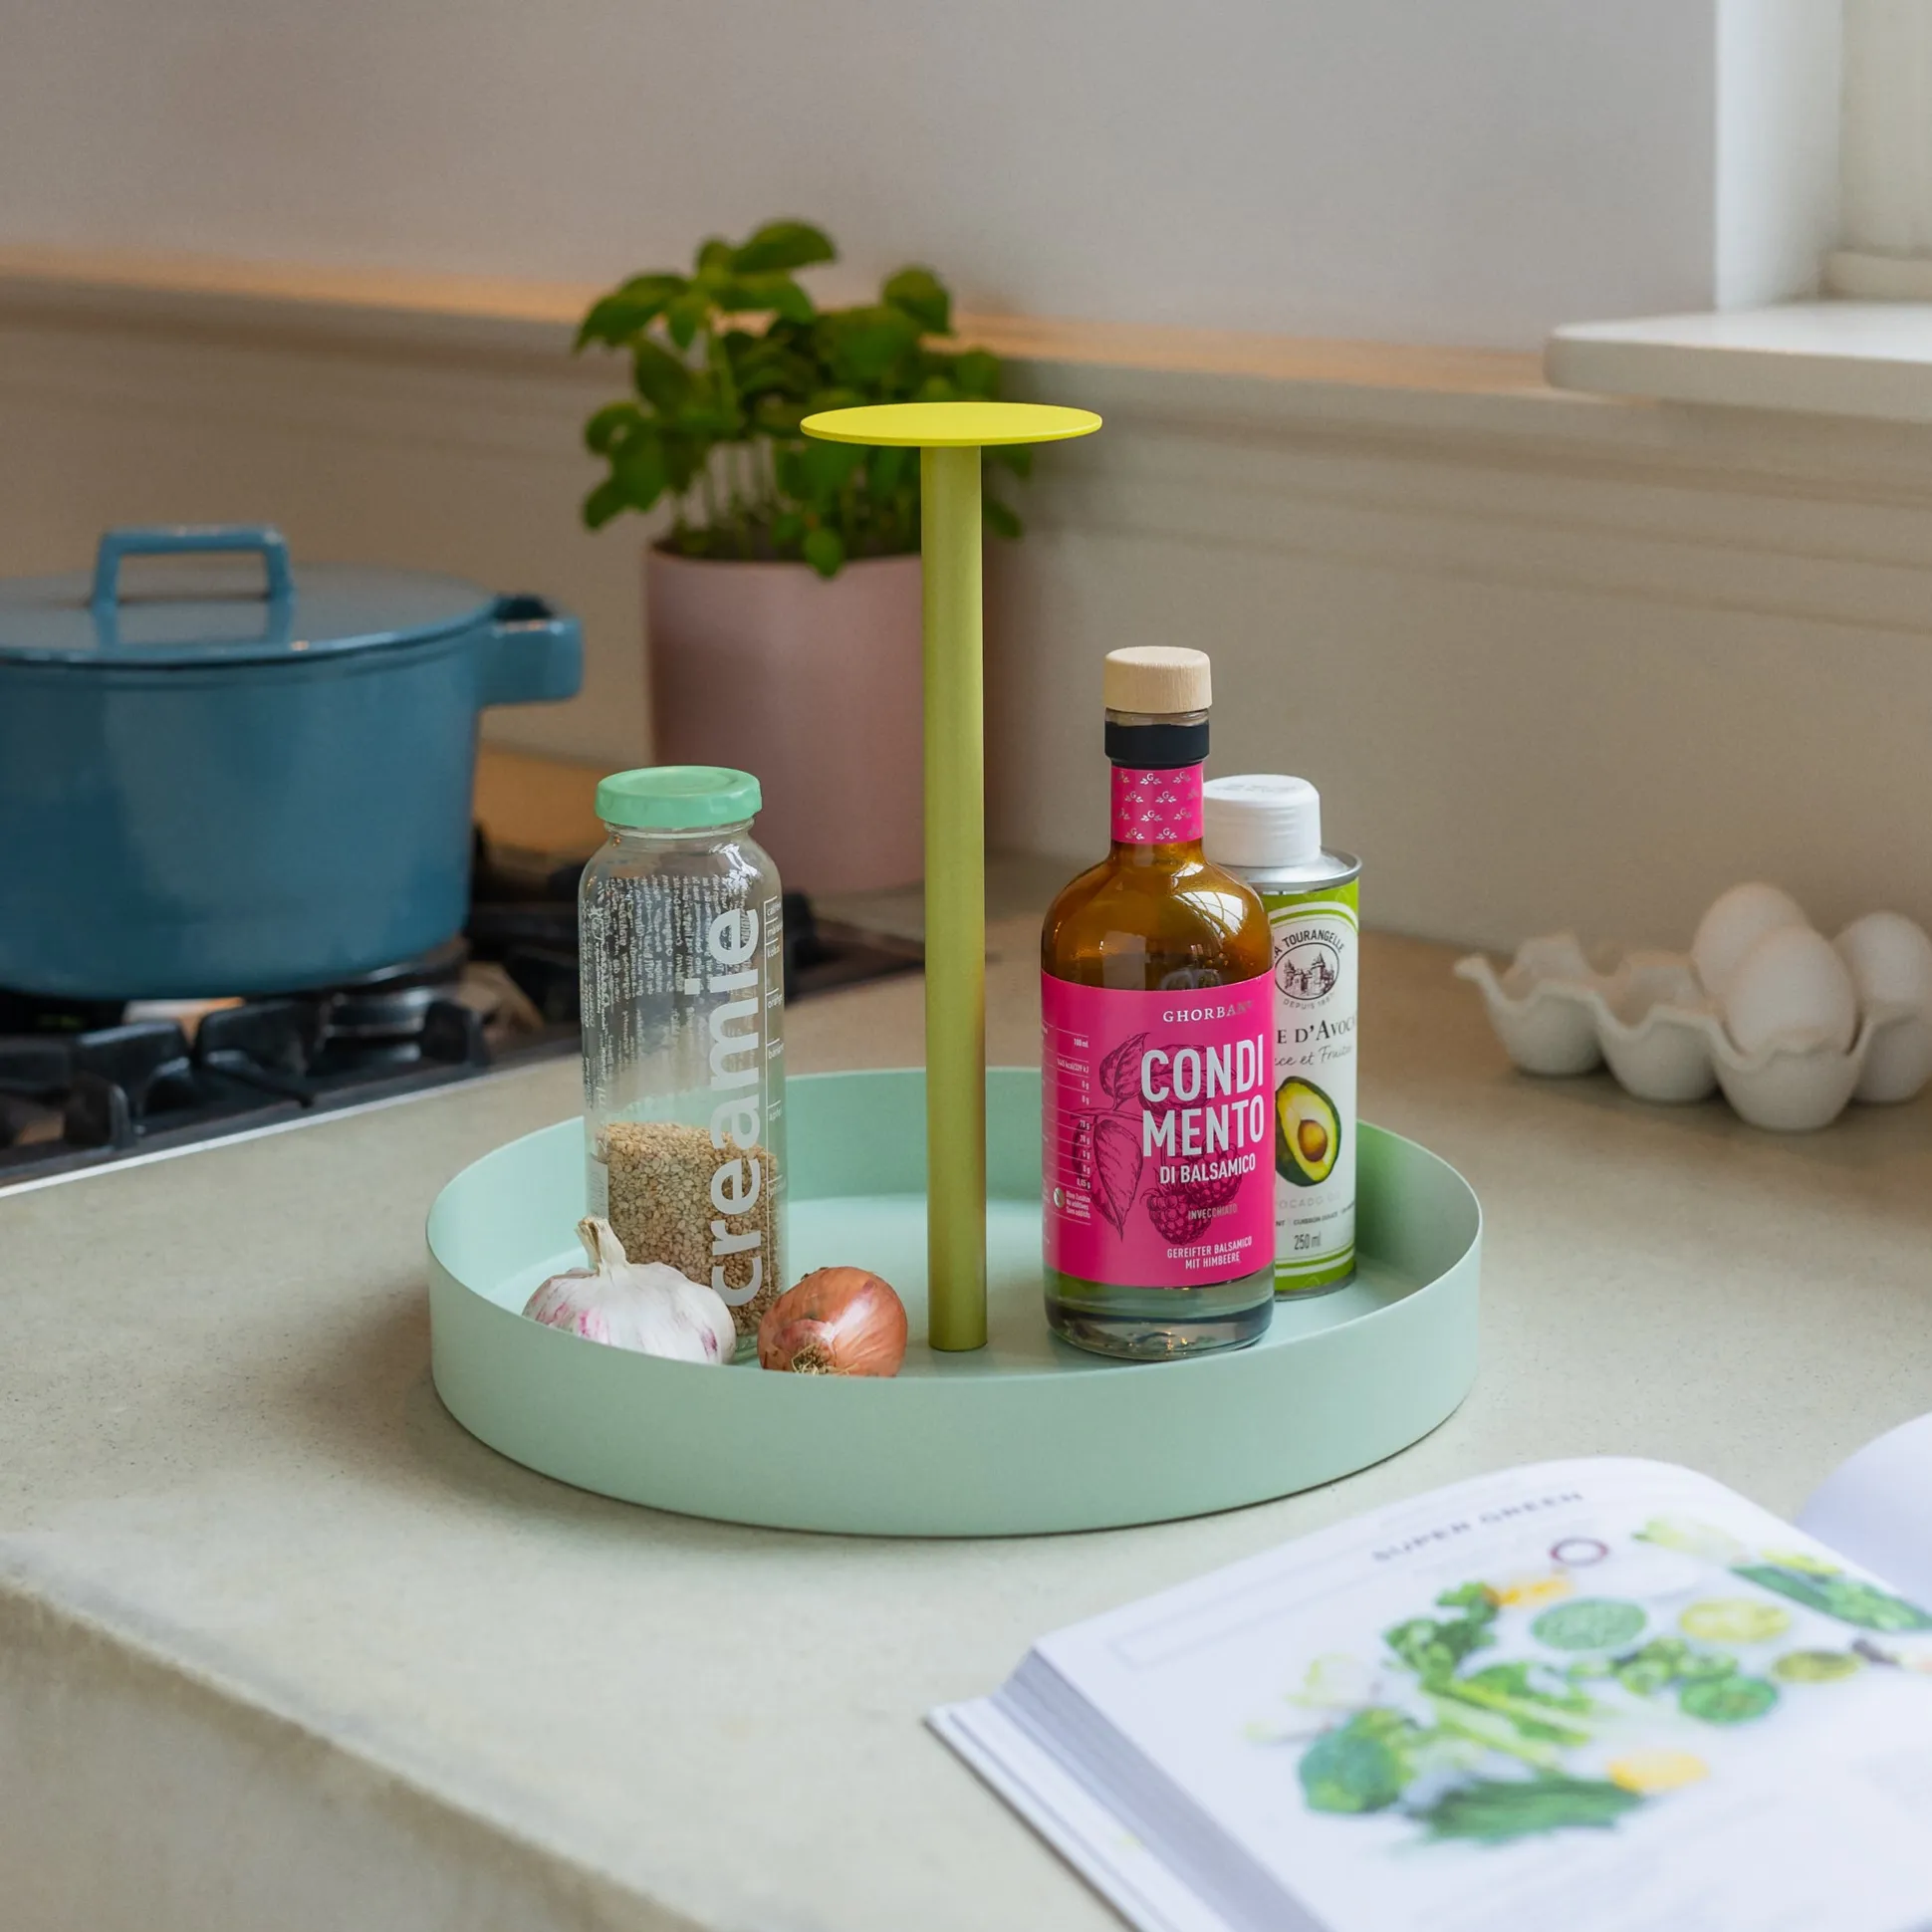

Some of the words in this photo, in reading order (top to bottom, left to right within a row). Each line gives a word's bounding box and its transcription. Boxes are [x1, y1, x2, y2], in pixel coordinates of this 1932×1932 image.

[1282, 929, 1344, 953] TOURANGELLE
[1283, 998, 1315, 1010] DEPUIS
[1141, 1033, 1264, 1103] CONDI
[1300, 1053, 1316, 1066] et
[684, 908, 763, 1307] creamie
[1142, 1094, 1264, 1157] MENTO
[1159, 1166, 1175, 1184] DI
[1180, 1152, 1256, 1183] BALSAMICO
[1188, 1203, 1238, 1221] INVECCHIATO
[1276, 1195, 1325, 1210] OCADO
[1167, 1245, 1212, 1259] GEREIFTER
[1214, 1236, 1253, 1253] BALSAMICO
[1294, 1234, 1311, 1250] 250
[1311, 1231, 1322, 1248] ml
[1185, 1258, 1200, 1270] MIT
[1203, 1251, 1240, 1268] HIMBEERE
